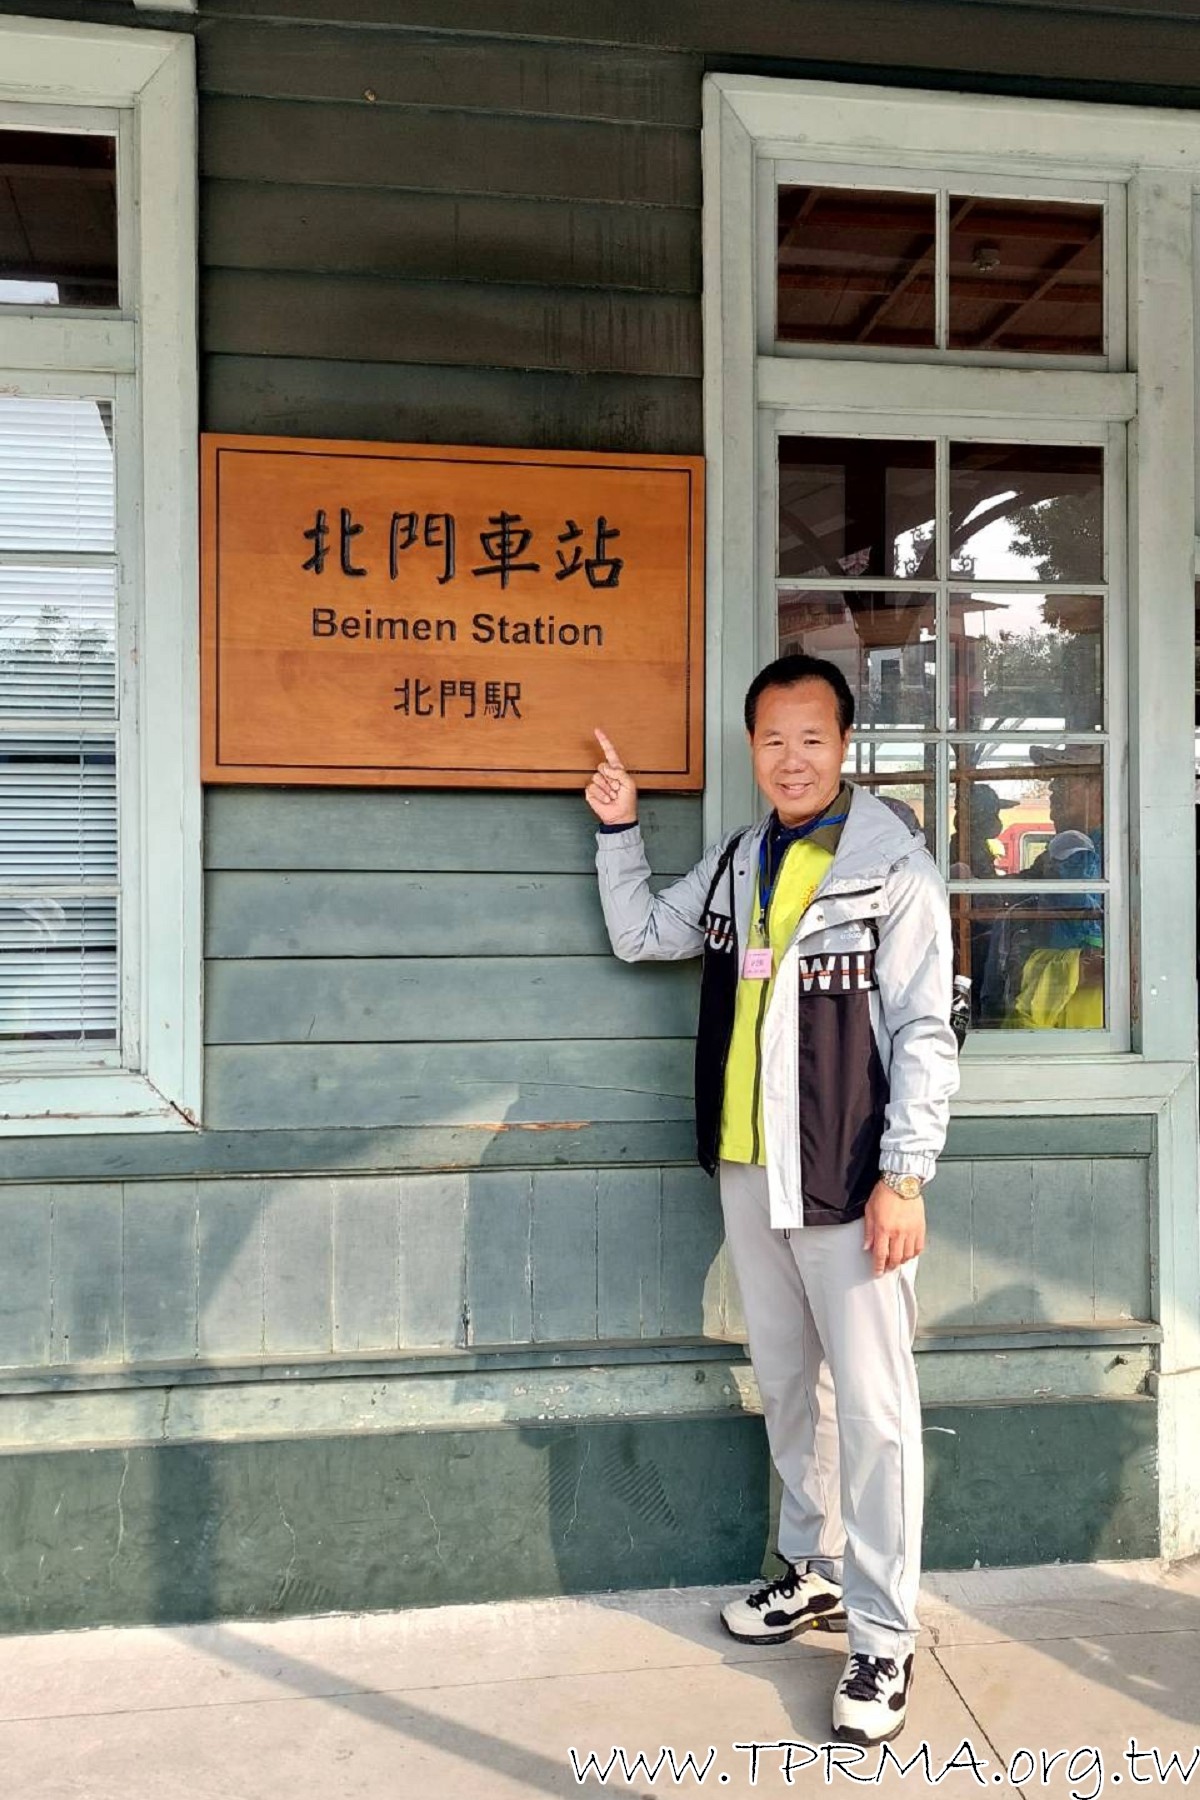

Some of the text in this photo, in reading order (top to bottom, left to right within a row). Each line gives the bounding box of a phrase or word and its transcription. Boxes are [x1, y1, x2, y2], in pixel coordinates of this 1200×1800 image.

[302, 507, 624, 590] 北門車站
[312, 608, 604, 646] Beimen Station
[394, 678, 522, 719] 北門駅
